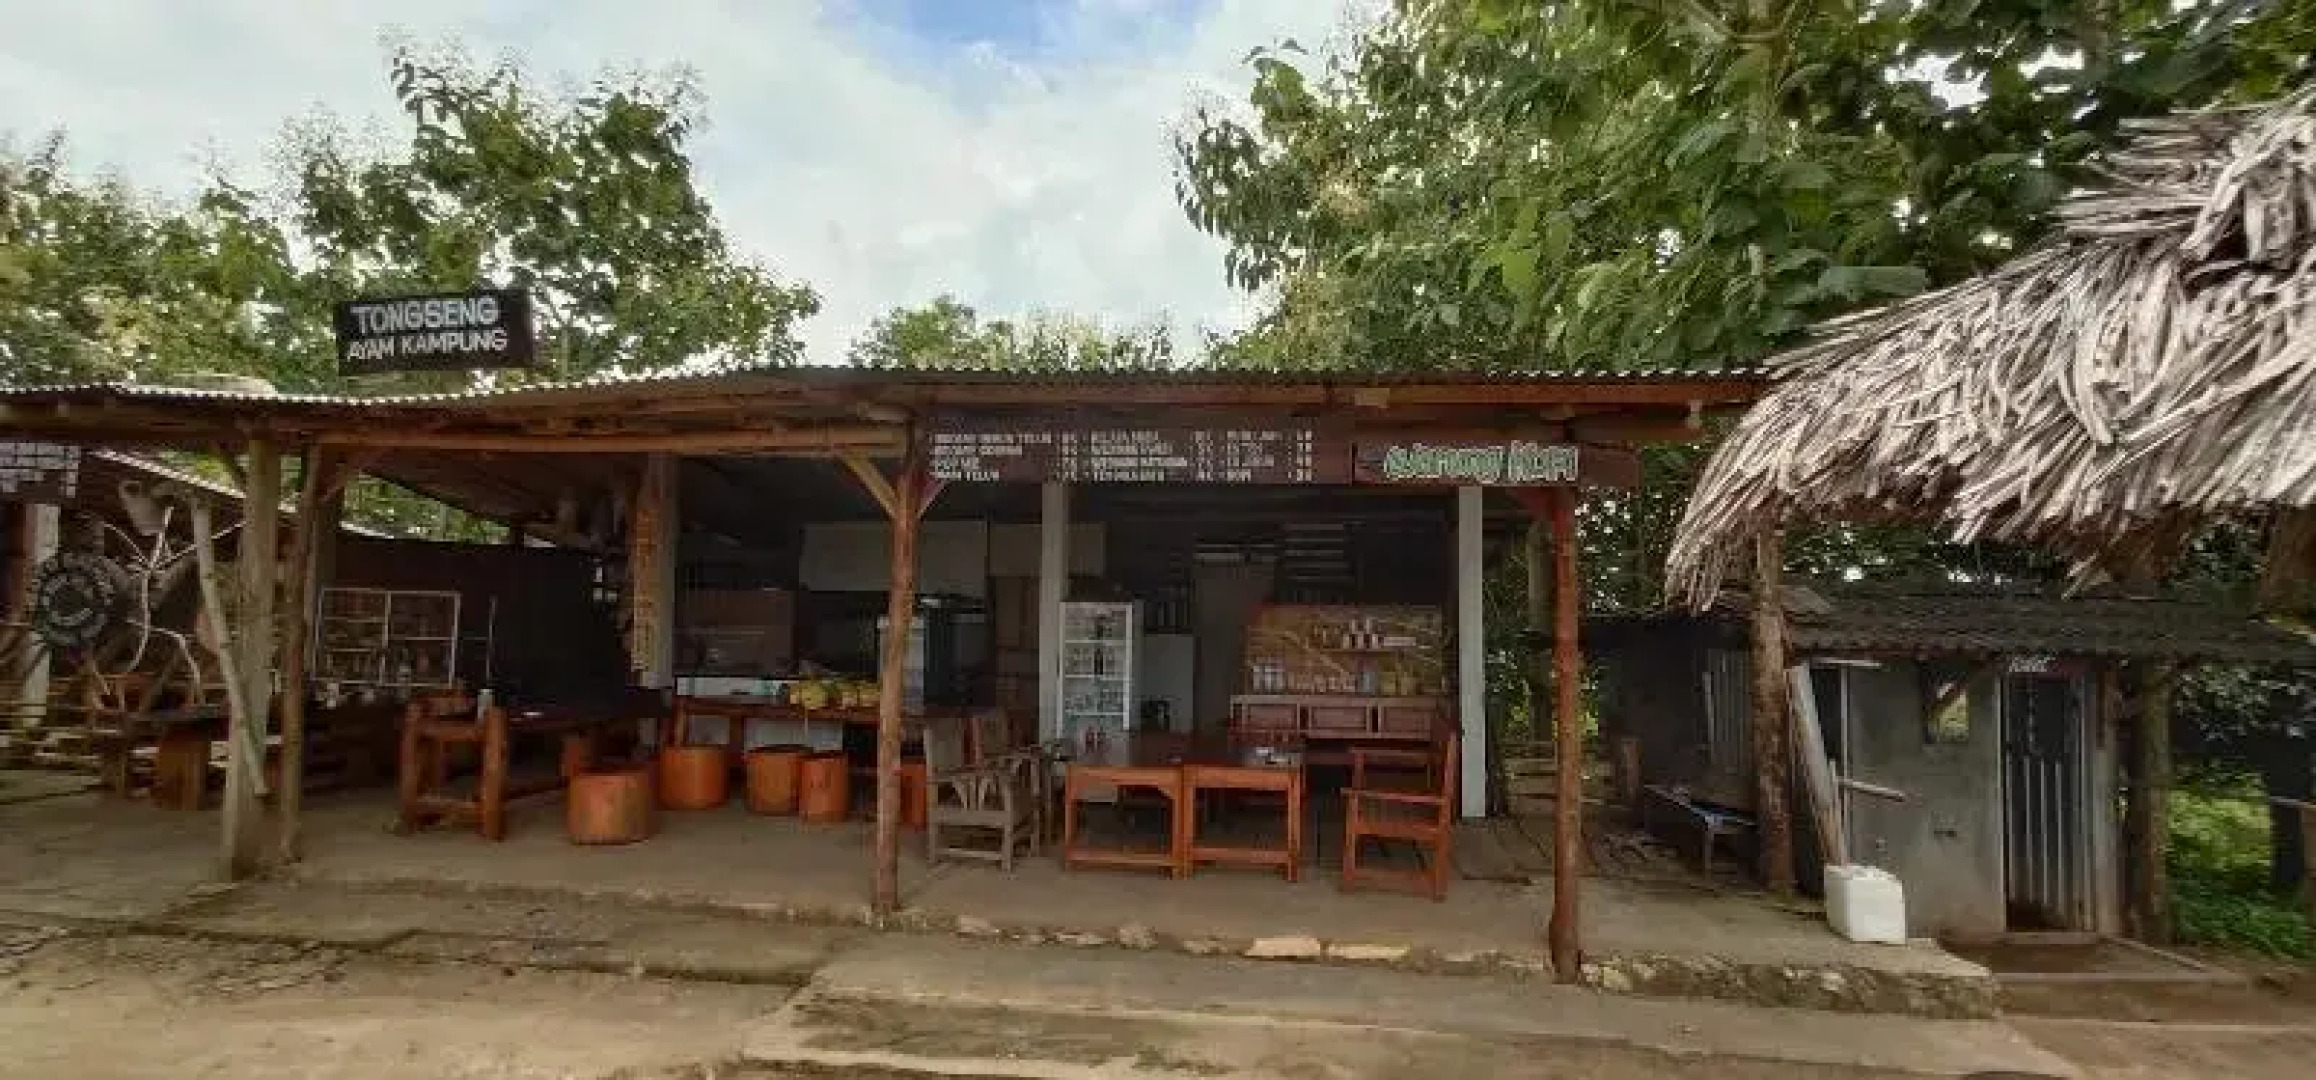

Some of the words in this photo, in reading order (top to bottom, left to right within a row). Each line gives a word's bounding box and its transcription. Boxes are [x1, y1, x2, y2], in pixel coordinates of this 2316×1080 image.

[350, 297, 498, 334] TONGSENG
[347, 336, 395, 361] AYAM
[402, 328, 508, 354] KAMPUNG
